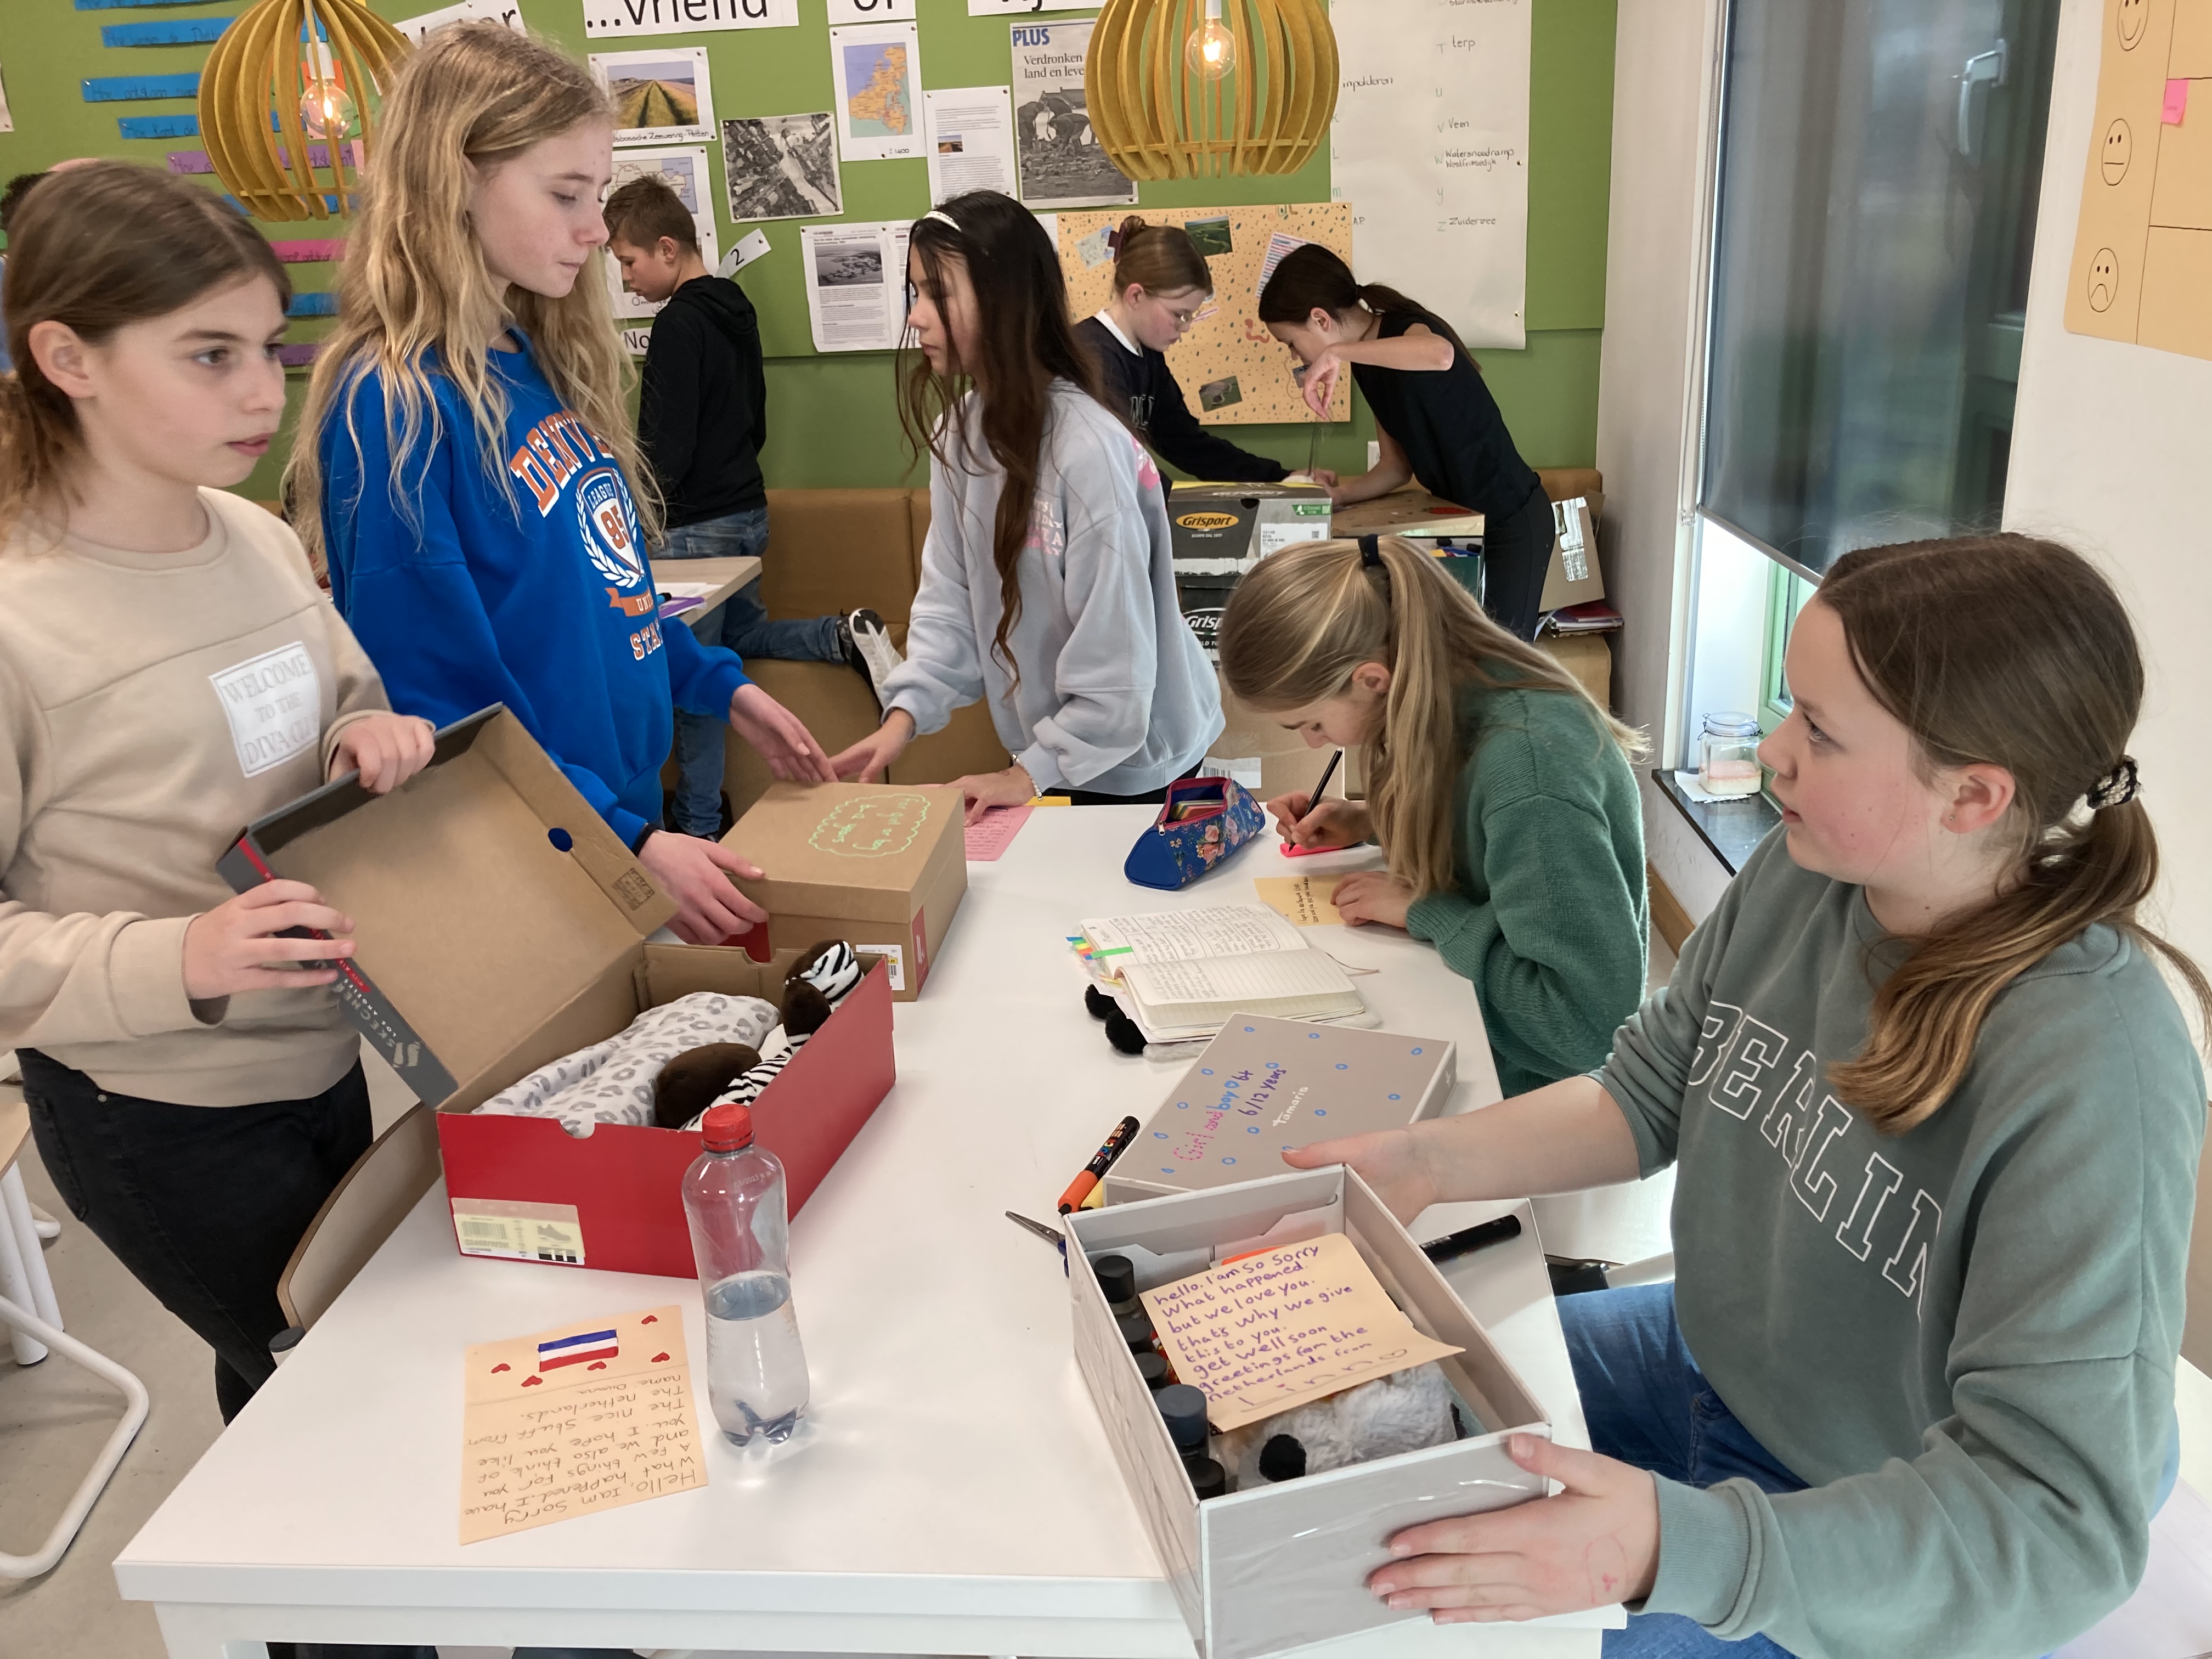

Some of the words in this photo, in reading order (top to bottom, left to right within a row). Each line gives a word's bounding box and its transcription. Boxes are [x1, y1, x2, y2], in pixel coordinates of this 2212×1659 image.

[1013, 29, 1050, 47] PLUS
[1452, 35, 1476, 52] terp
[1024, 53, 1083, 65] Verdronken
[1024, 67, 1047, 78] land
[1050, 69, 1062, 77] en
[1065, 66, 1085, 77] leve
[1448, 117, 1469, 128] Veen
[1449, 217, 1496, 225] Zuiderzee
[730, 249, 744, 266] 2
[623, 331, 650, 349] No
[1183, 516, 1232, 527] Grisport
[1186, 615, 1223, 630] Grisp
[630, 617, 663, 661] STA
[221, 654, 312, 704] WELCOME
[255, 704, 275, 723] TO
[275, 691, 301, 714] THE
[244, 730, 291, 765] DIVA
[343, 978, 379, 1015] ANGELES
[332, 982, 397, 1048] SKECHER
[381, 1020, 397, 1037] LOS
[1172, 1132, 1216, 1161] Girl
[1205, 1091, 1240, 1111] boy
[1222, 1261, 1308, 1294] happened.
[1153, 1283, 1204, 1305] hello.
[1167, 1316, 1201, 1334] but
[1205, 1305, 1234, 1321] we
[1235, 1288, 1276, 1309] love
[1281, 1279, 1316, 1297] you.
[1177, 1326, 1229, 1351] that's
[1284, 1297, 1314, 1312] we
[1319, 1286, 1353, 1302] give
[1185, 1347, 1221, 1363] this
[1224, 1338, 1244, 1351] to
[1250, 1326, 1287, 1344] you.
[1193, 1357, 1231, 1379] get
[1235, 1337, 1285, 1359] well
[1288, 1324, 1328, 1342] soon
[1334, 1342, 1372, 1357] from
[1198, 1353, 1291, 1393] greetings
[1330, 1327, 1368, 1342] the
[652, 1386, 685, 1398] The
[520, 1392, 637, 1421] netherlands.
[591, 1408, 633, 1421] nice
[648, 1400, 685, 1412] The
[647, 1414, 686, 1429] you.
[627, 1426, 639, 1435] I
[652, 1427, 690, 1444] and
[467, 1433, 508, 1447] from
[616, 1440, 640, 1453] we
[681, 1443, 691, 1453] A
[528, 1443, 558, 1458] you
[572, 1447, 610, 1462] also
[477, 1454, 514, 1468] like
[515, 1455, 562, 1479] think
[567, 1458, 621, 1479] things
[476, 1471, 499, 1483] of
[630, 1469, 697, 1493] Hello,
[482, 1486, 509, 1499] you
[462, 1501, 506, 1516] have
[515, 1497, 529, 1508] I
